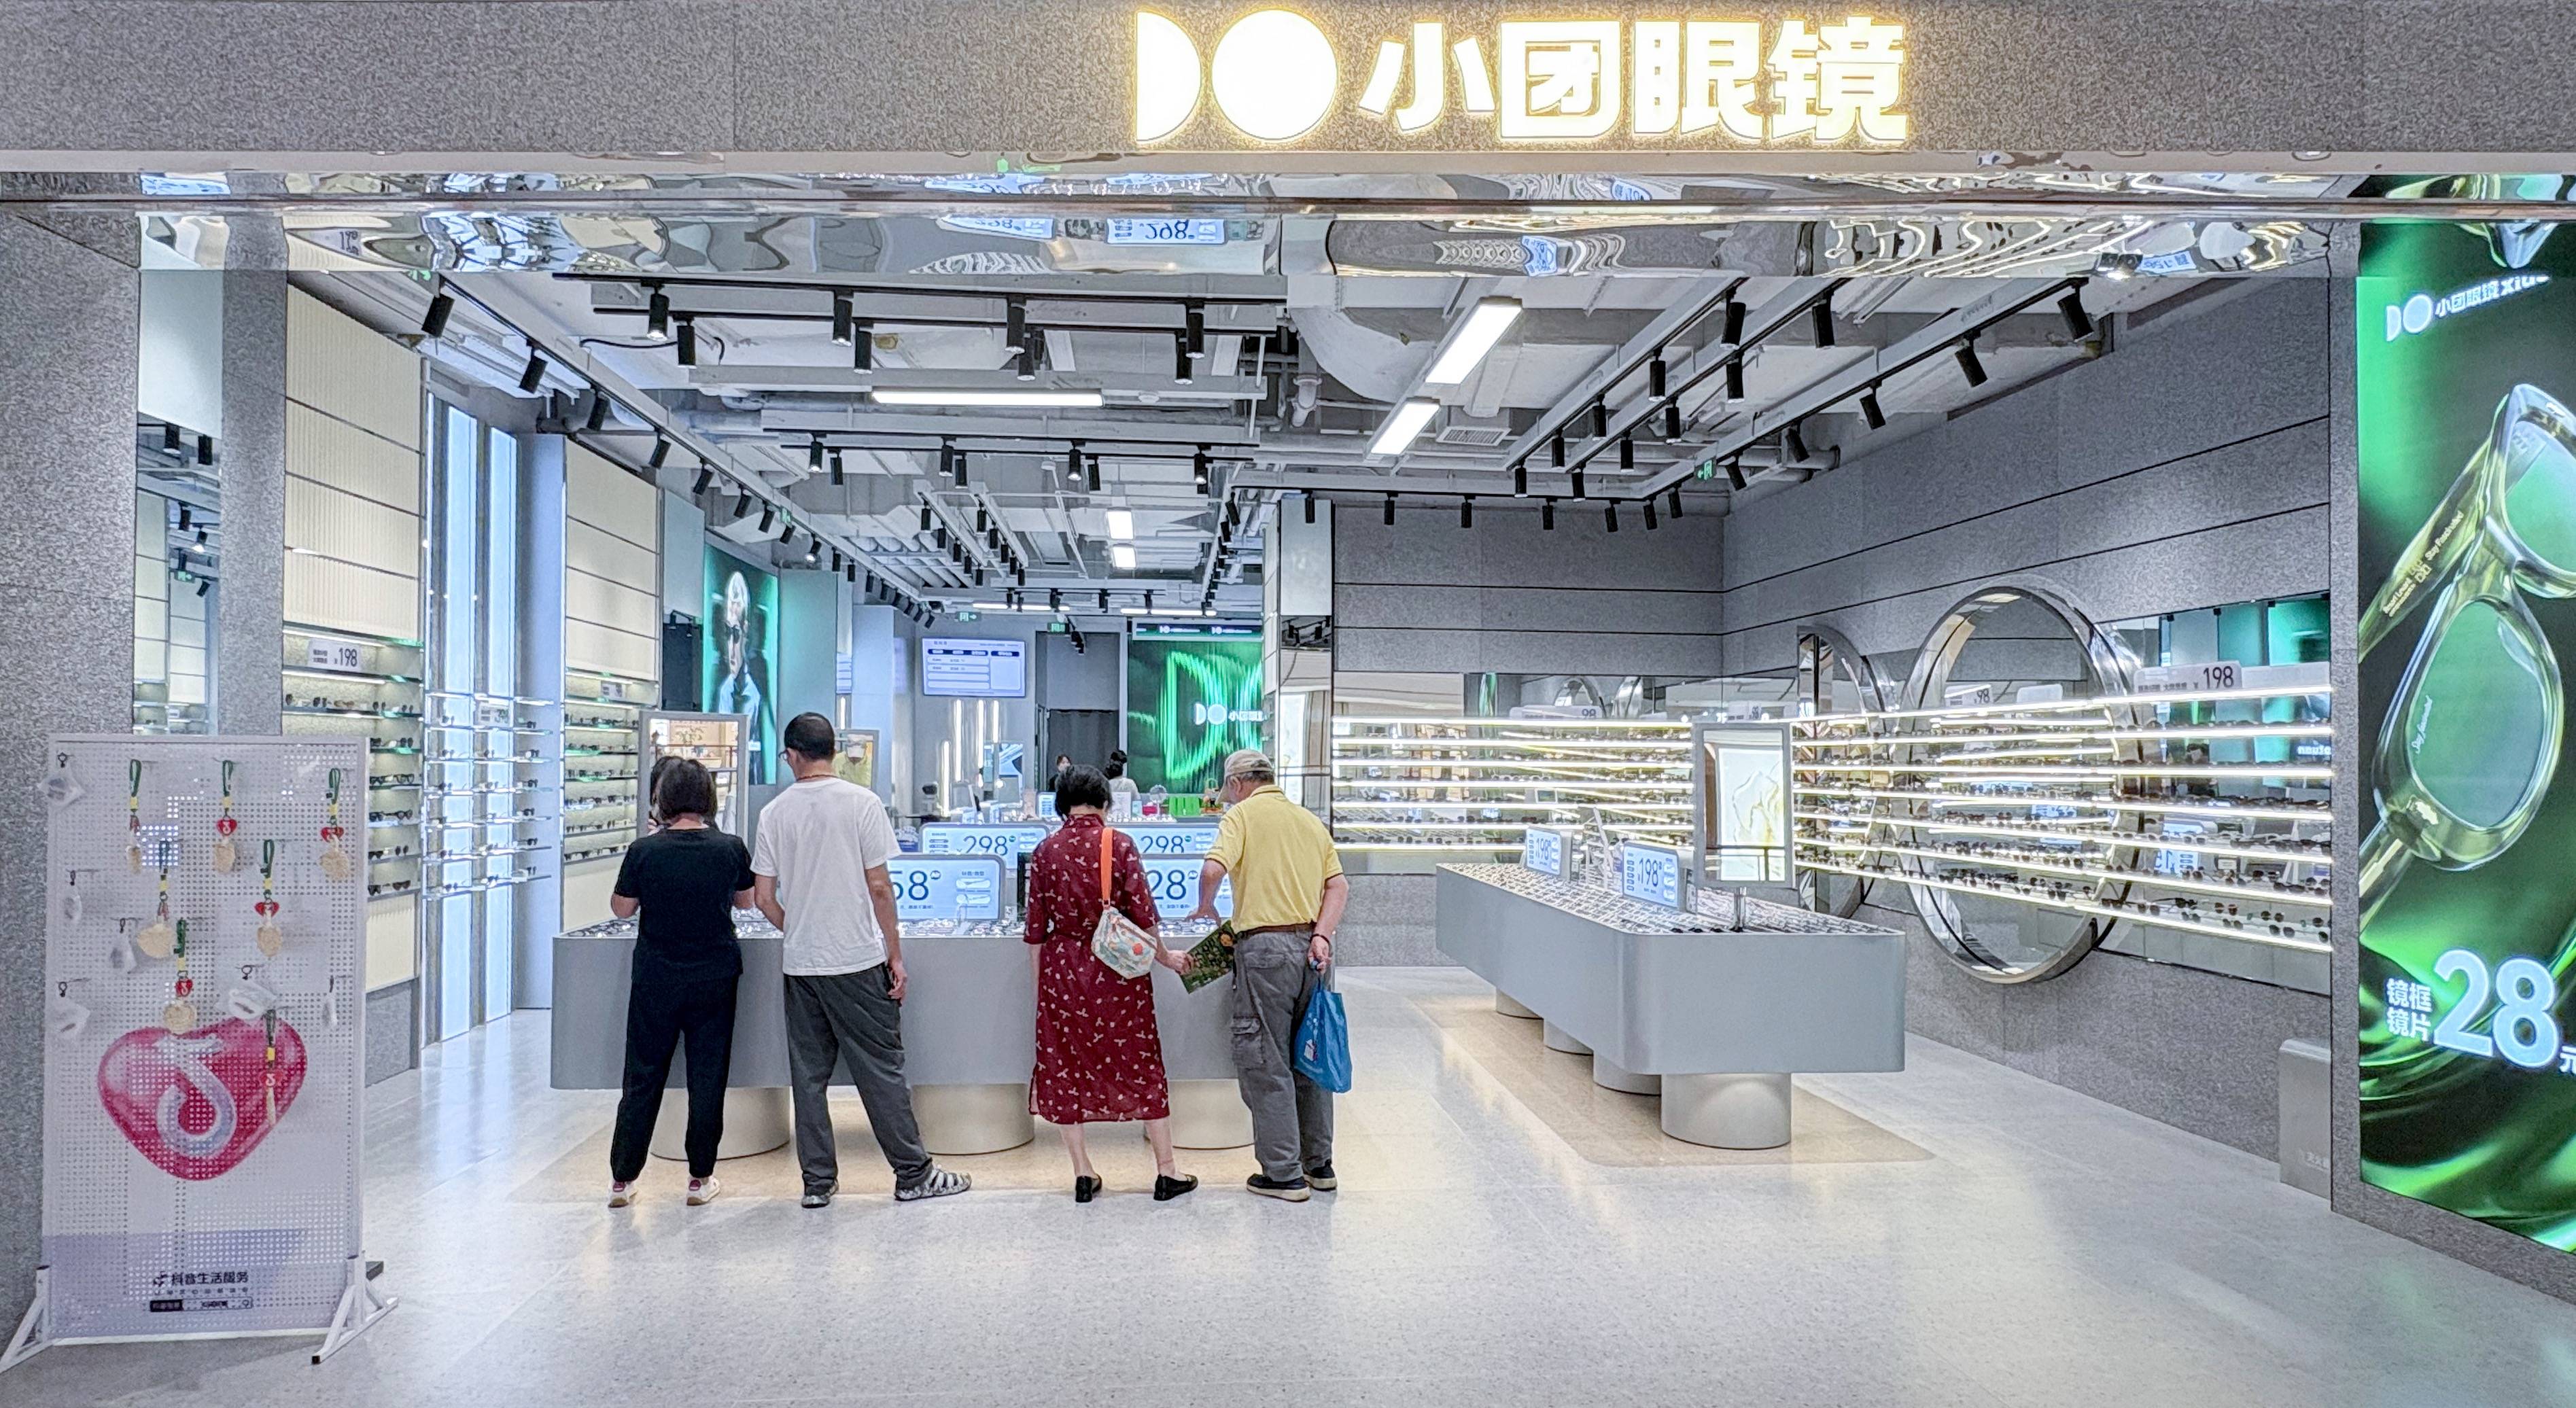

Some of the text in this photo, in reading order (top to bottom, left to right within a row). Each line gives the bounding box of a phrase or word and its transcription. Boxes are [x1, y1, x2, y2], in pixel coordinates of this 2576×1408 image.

[1137, 10, 1907, 141] DO 小团眼镜
[2435, 280, 2500, 317] 小团眼镜
[339, 648, 358, 667] 198
[2204, 666, 2234, 688] 198
[963, 835, 1009, 856] 298
[1141, 836, 1184, 853] 298
[1147, 870, 1187, 900] 28
[1639, 858, 1658, 887] 198
[2386, 978, 2433, 1013] 镜框
[2386, 1006, 2432, 1042] 镜片
